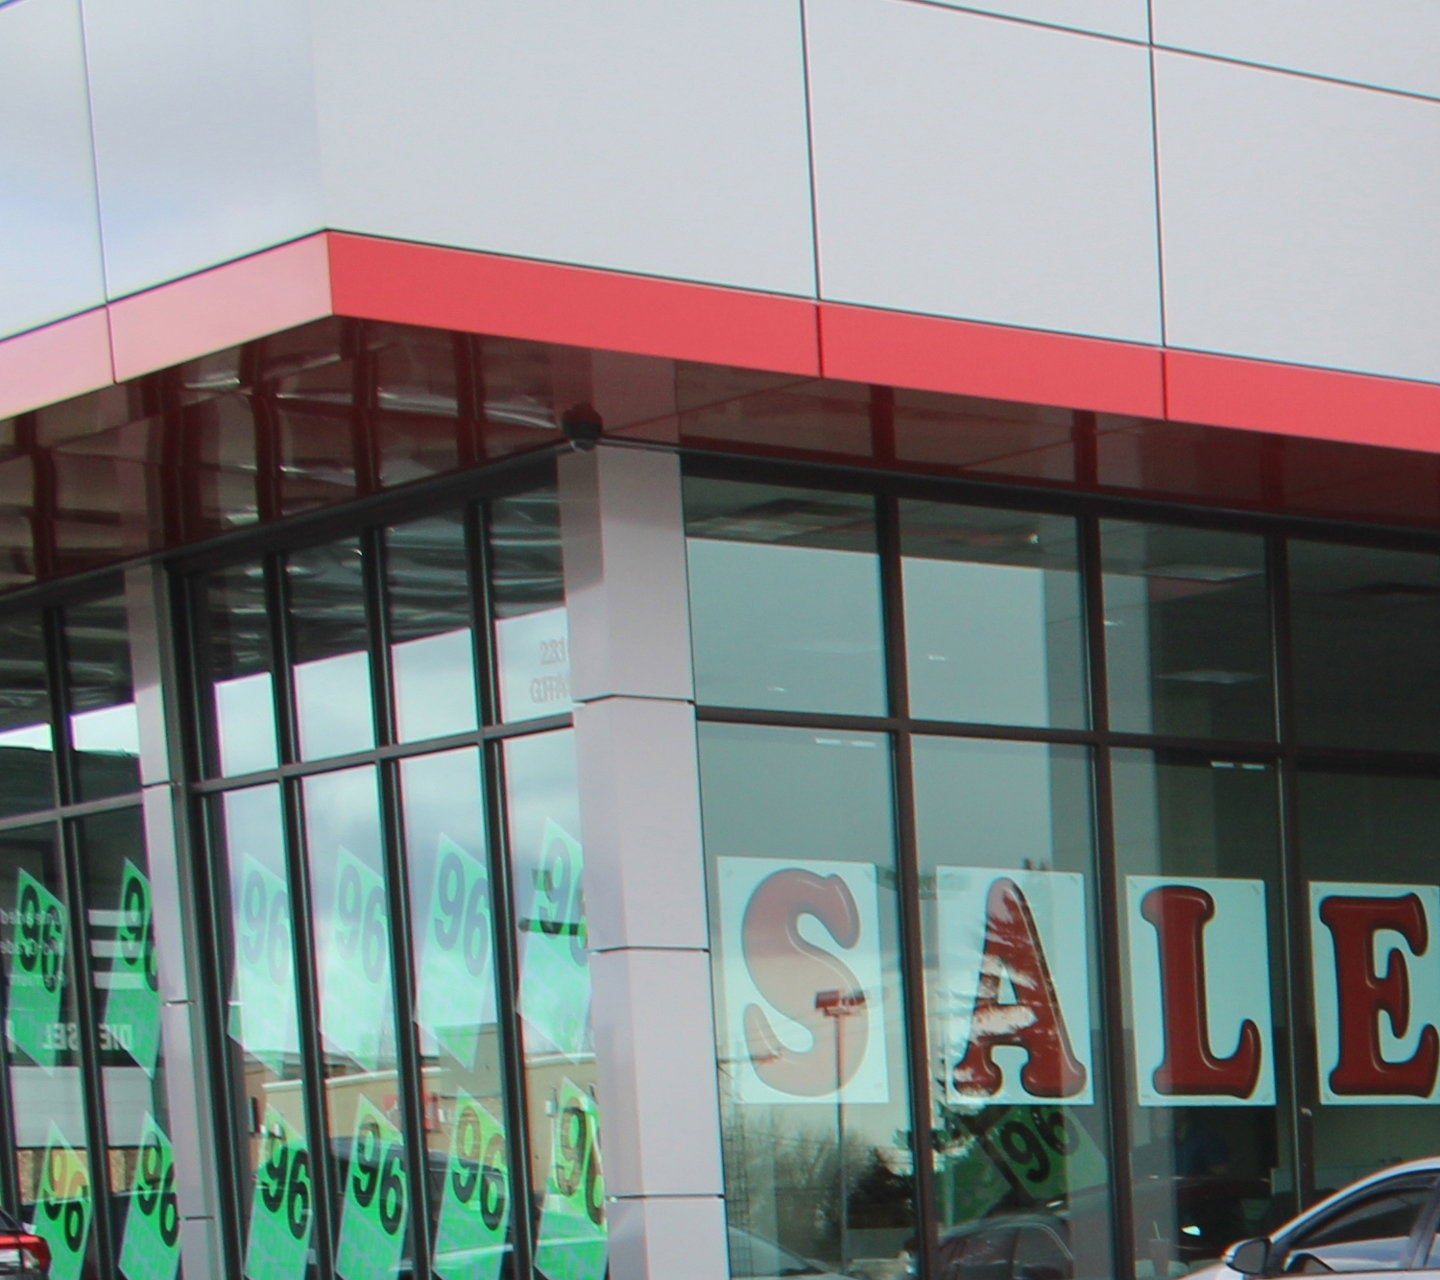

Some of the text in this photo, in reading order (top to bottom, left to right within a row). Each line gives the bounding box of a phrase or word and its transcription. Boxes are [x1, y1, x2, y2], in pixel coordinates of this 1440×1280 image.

[20, 884, 62, 994] 96
[243, 869, 290, 986] 96
[334, 864, 387, 984] 96
[434, 852, 489, 977] 96
[741, 867, 1440, 1100] SALE
[44, 1152, 88, 1253] 96
[138, 1130, 180, 1248] 96
[260, 1121, 311, 1241] 96
[352, 1117, 407, 1236] 96
[452, 1106, 506, 1232] 96
[1001, 1105, 1079, 1183] 96
